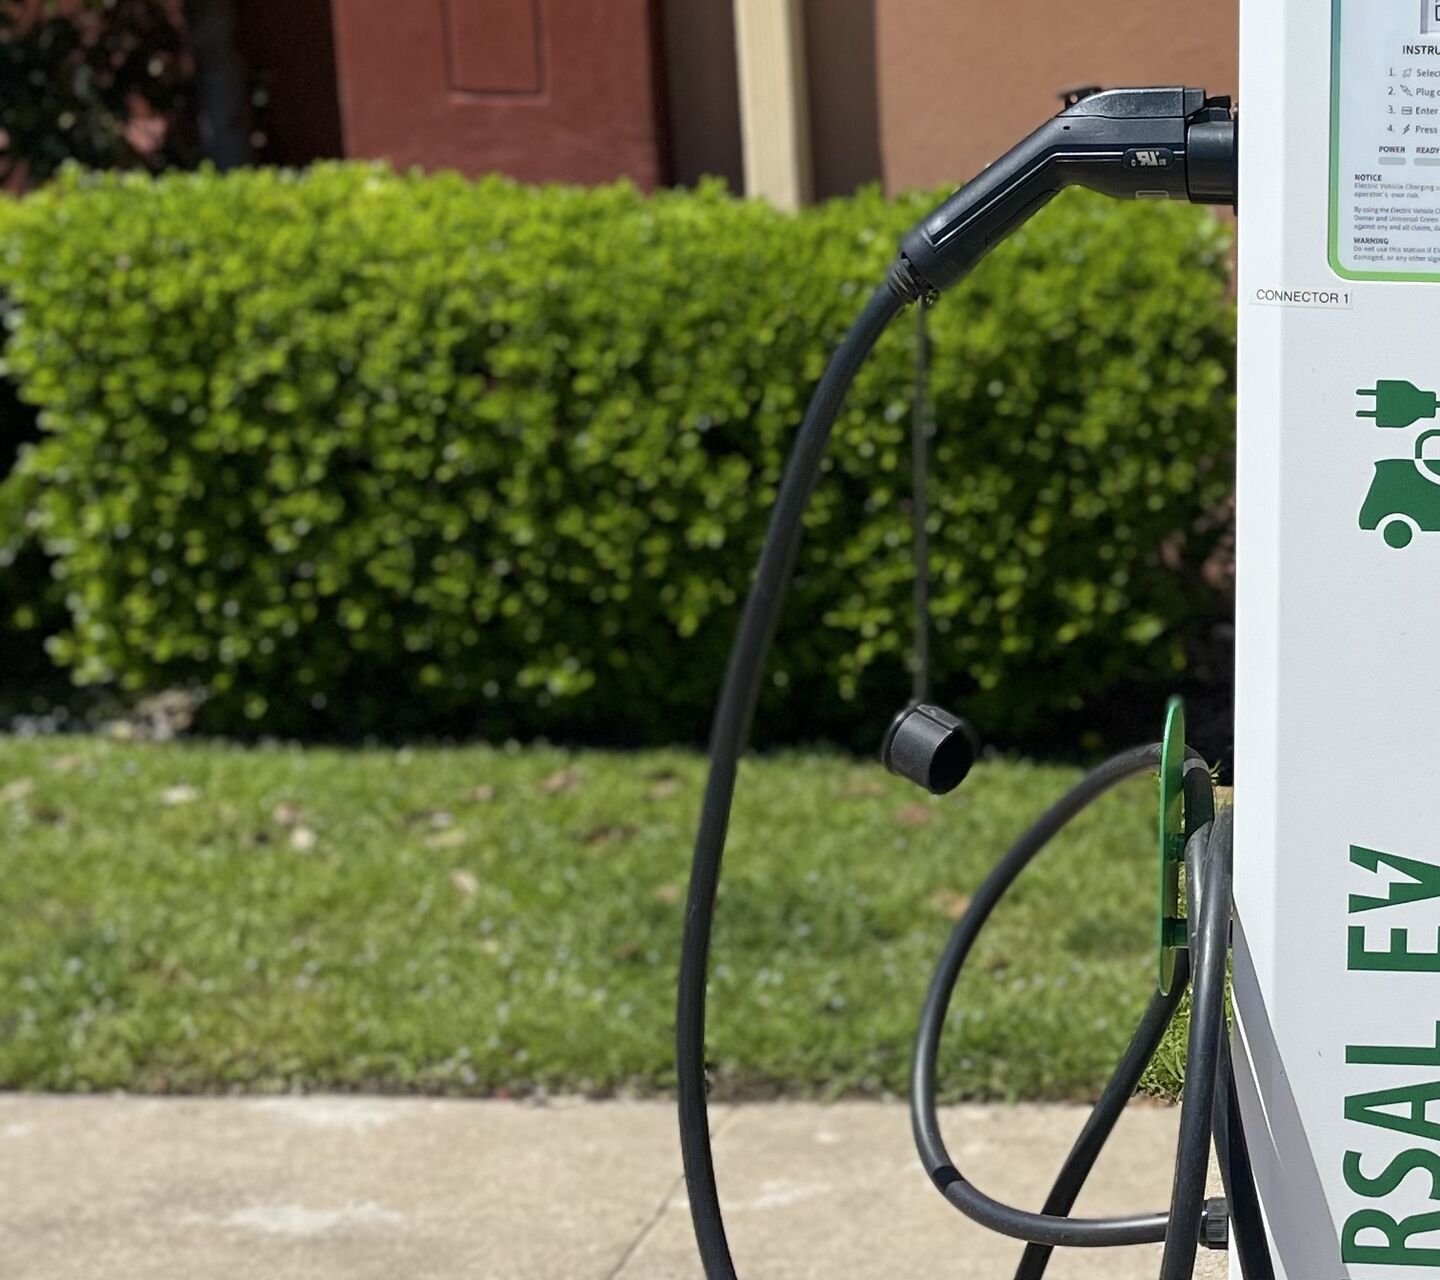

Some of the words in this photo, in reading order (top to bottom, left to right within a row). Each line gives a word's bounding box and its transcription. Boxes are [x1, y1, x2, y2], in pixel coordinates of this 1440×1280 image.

[1415, 88, 1435, 98] Plug
[1415, 106, 1439, 115] Enter
[1415, 125, 1438, 134] Press
[1378, 146, 1406, 154] POWER
[1256, 288, 1338, 305] CONNECTOR
[1343, 293, 1349, 304] 1
